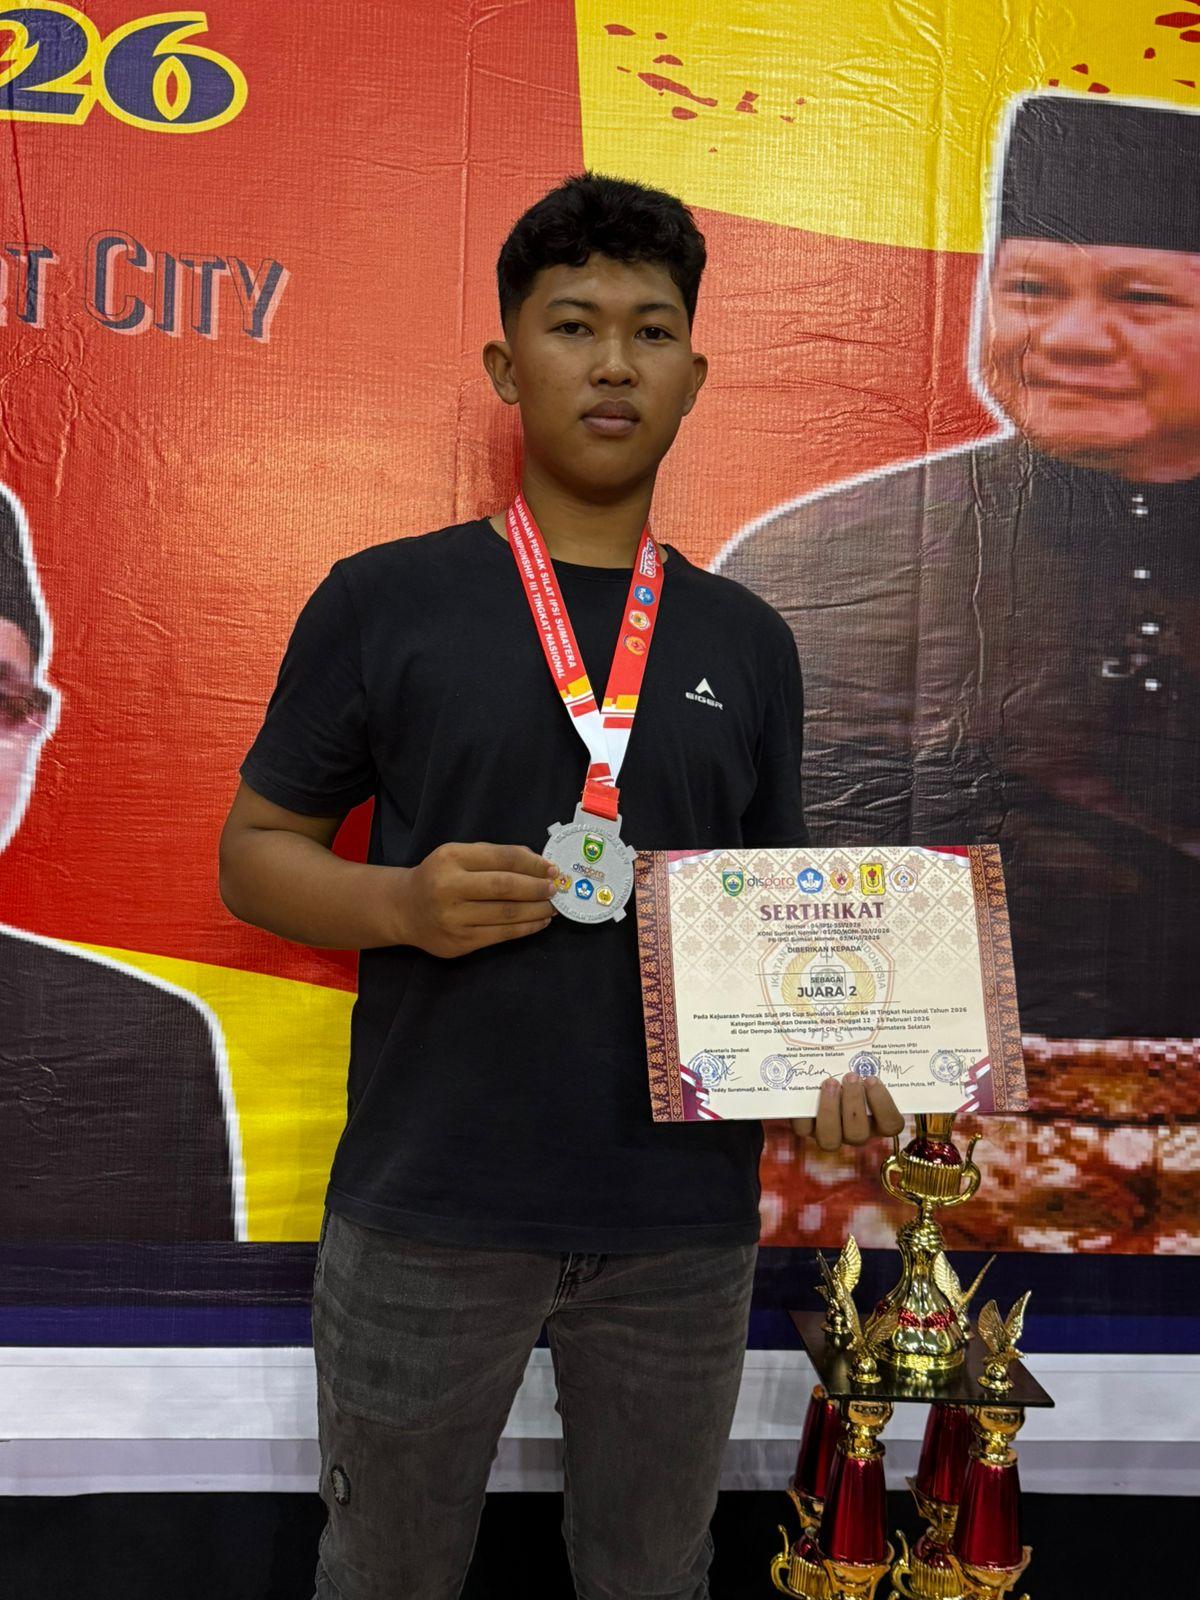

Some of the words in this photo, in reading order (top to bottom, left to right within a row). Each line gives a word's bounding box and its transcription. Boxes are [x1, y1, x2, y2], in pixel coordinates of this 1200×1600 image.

[0, 242, 58, 329] T
[511, 525, 535, 580] CHAMPIONSHIP
[529, 538, 547, 570] PENCAK
[528, 581, 539, 591] III
[540, 572, 555, 598] SILAT
[532, 593, 552, 631] TINGKAT
[548, 598, 561, 616] IPSI
[554, 617, 577, 669] SUMATERA
[544, 633, 566, 679] NASIONAL
[685, 691, 724, 711] EIGER
[760, 902, 884, 921] SERTIFIKAT
[787, 945, 829, 953] DIBERIKAN
[810, 976, 844, 984] SEBAGAI
[797, 986, 845, 998] JUARA
[848, 986, 858, 997] 2
